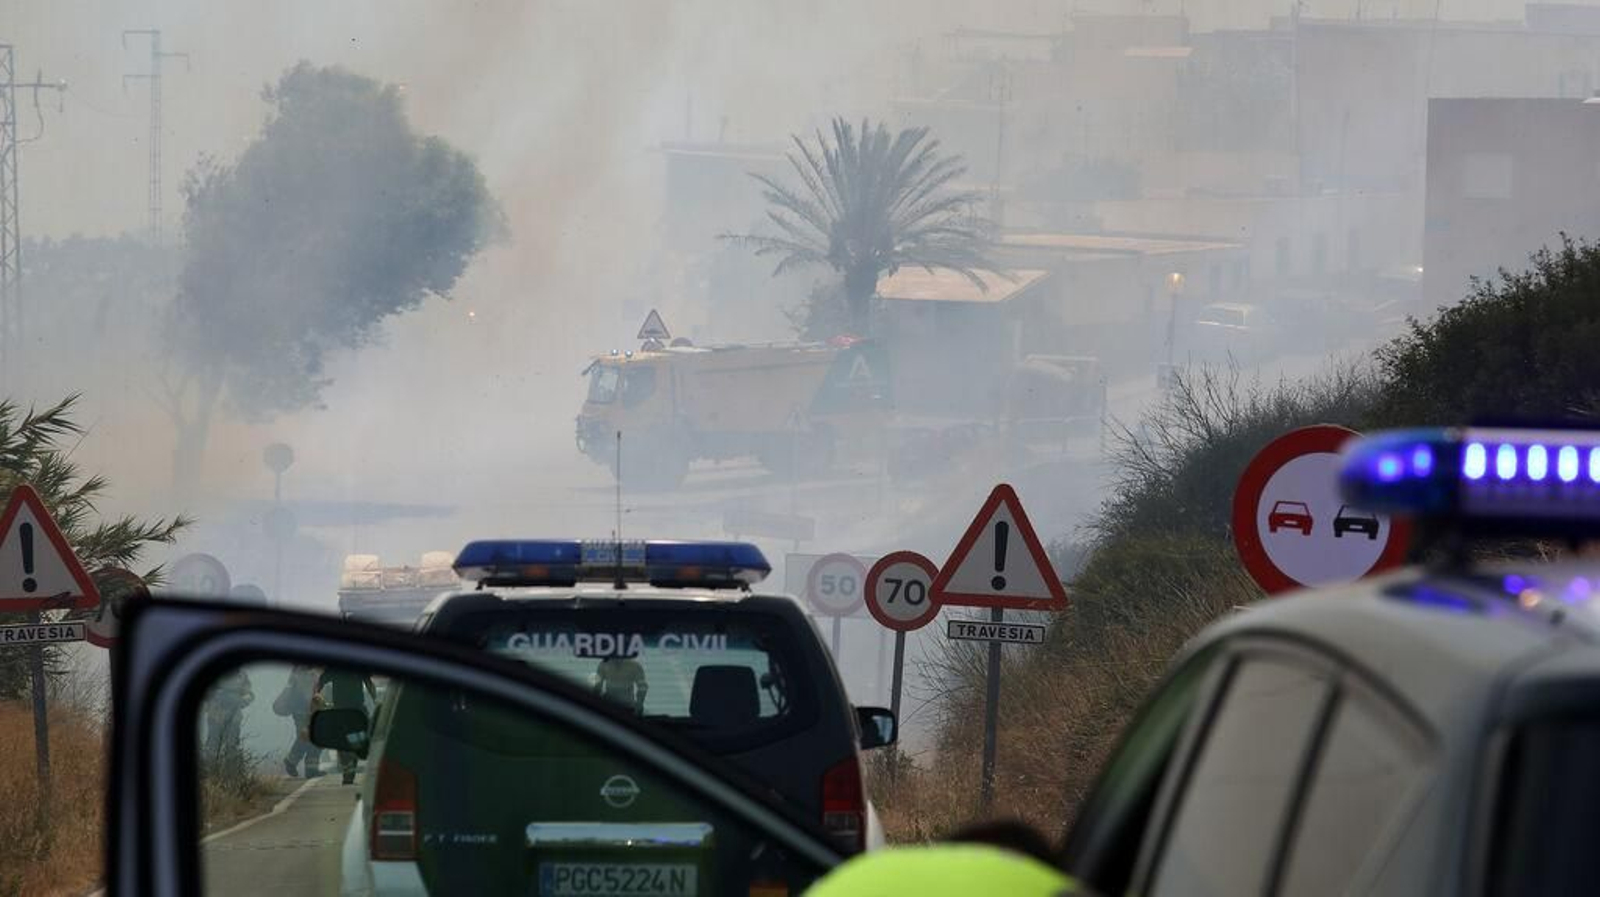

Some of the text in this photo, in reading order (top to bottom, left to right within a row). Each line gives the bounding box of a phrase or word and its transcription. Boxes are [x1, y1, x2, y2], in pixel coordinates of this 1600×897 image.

[821, 574, 856, 596] 50
[884, 577, 926, 606] 70
[957, 624, 1035, 641] TRAVESIA
[507, 633, 728, 656] GUARDIA CIVIL
